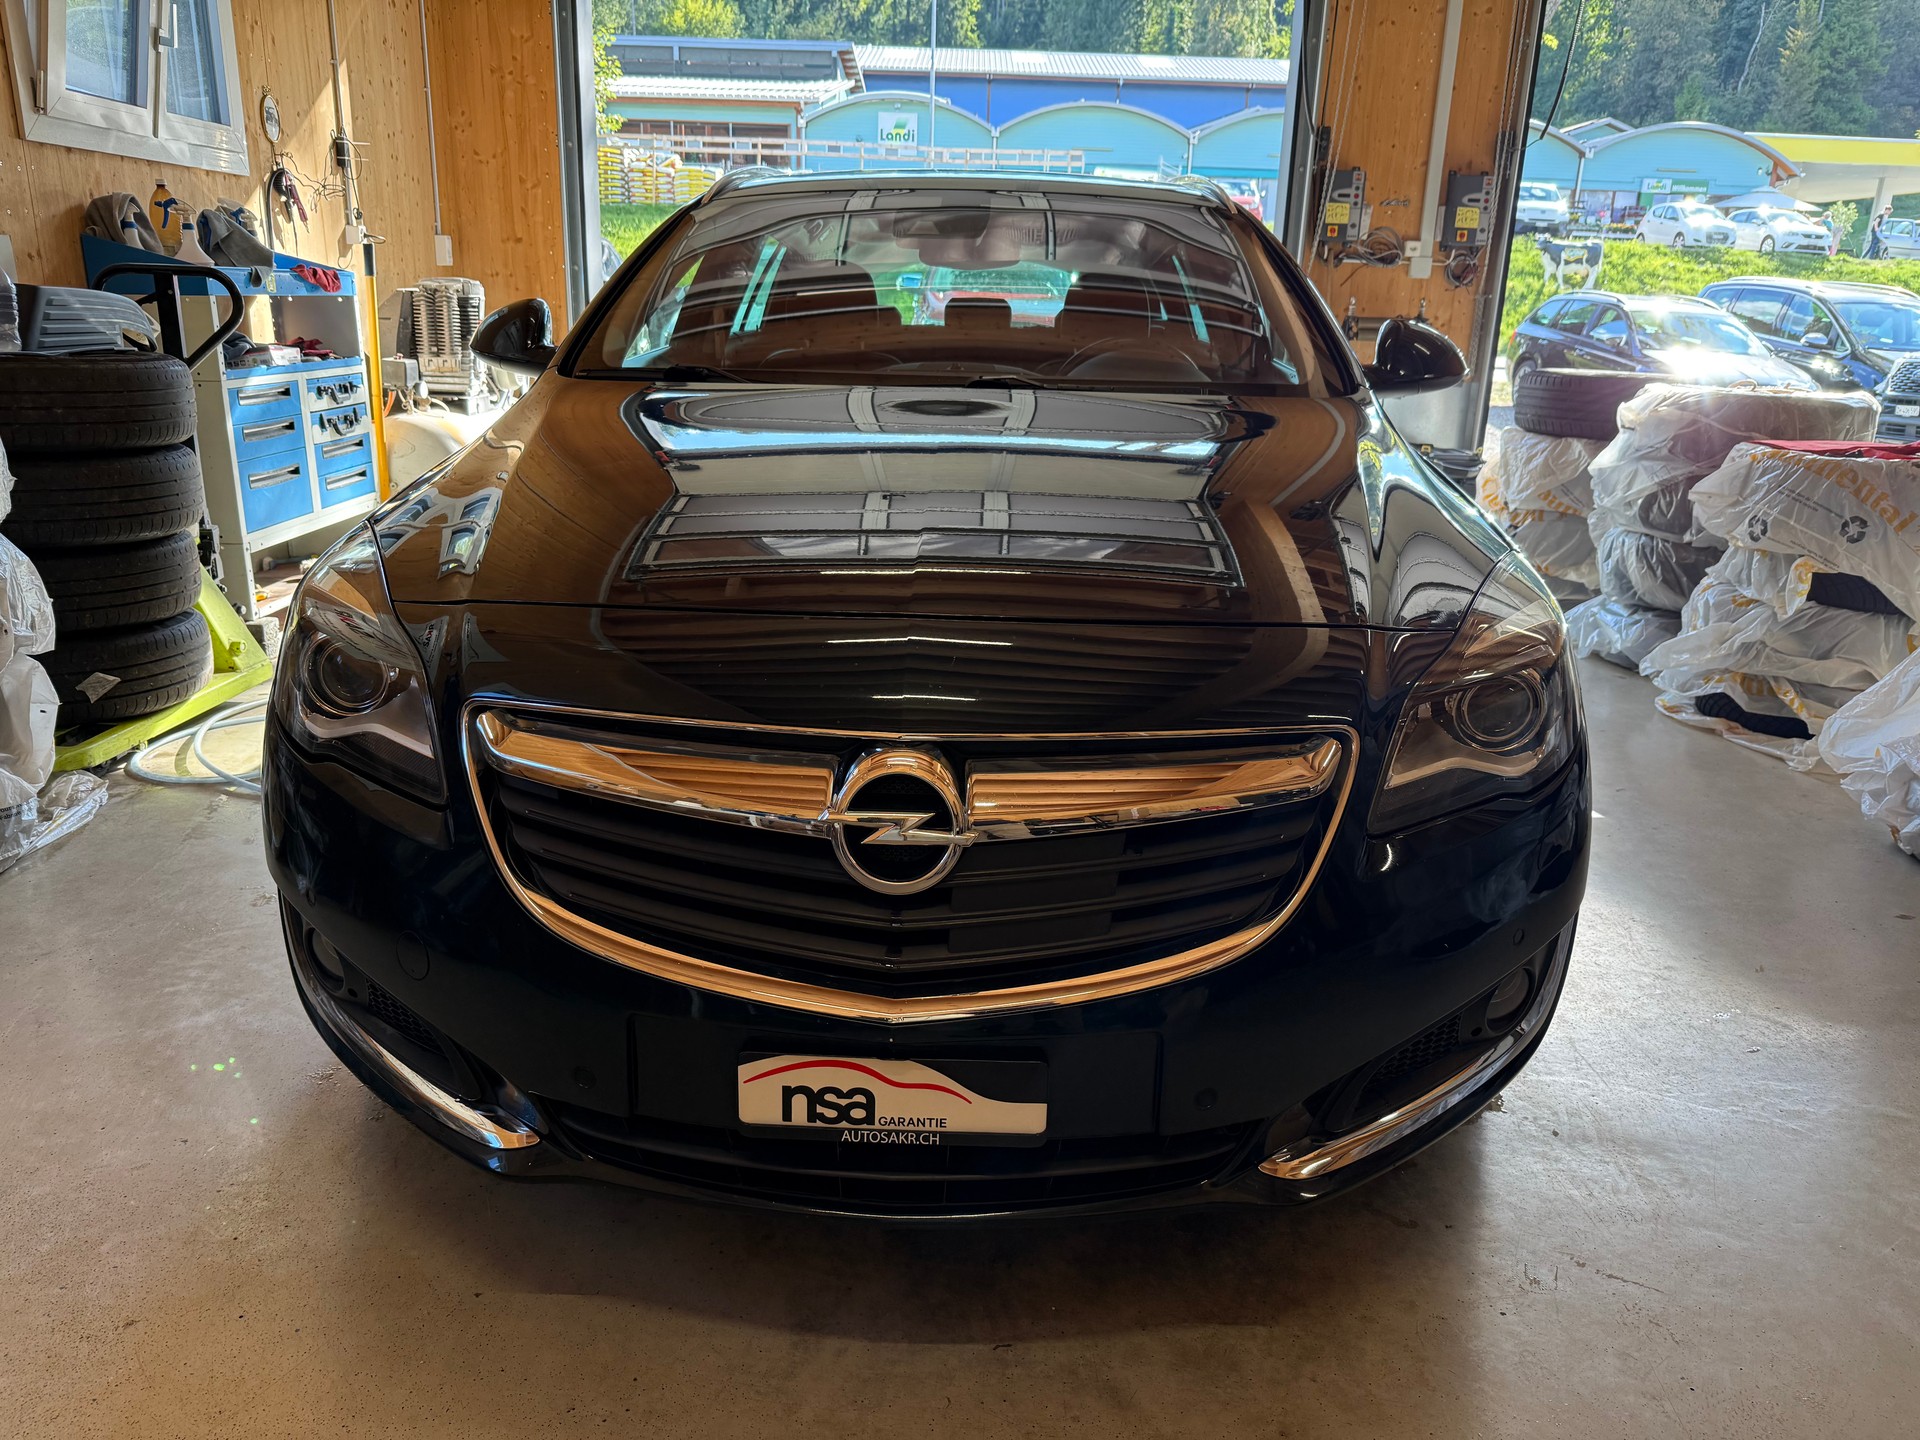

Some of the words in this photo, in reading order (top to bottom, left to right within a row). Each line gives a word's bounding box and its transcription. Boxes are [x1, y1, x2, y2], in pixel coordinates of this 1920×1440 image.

[880, 128, 915, 142] Landi
[782, 1085, 876, 1126] nsa
[878, 1116, 948, 1129] GARANTIE
[841, 1129, 940, 1146] AUTOSAKR.CH
